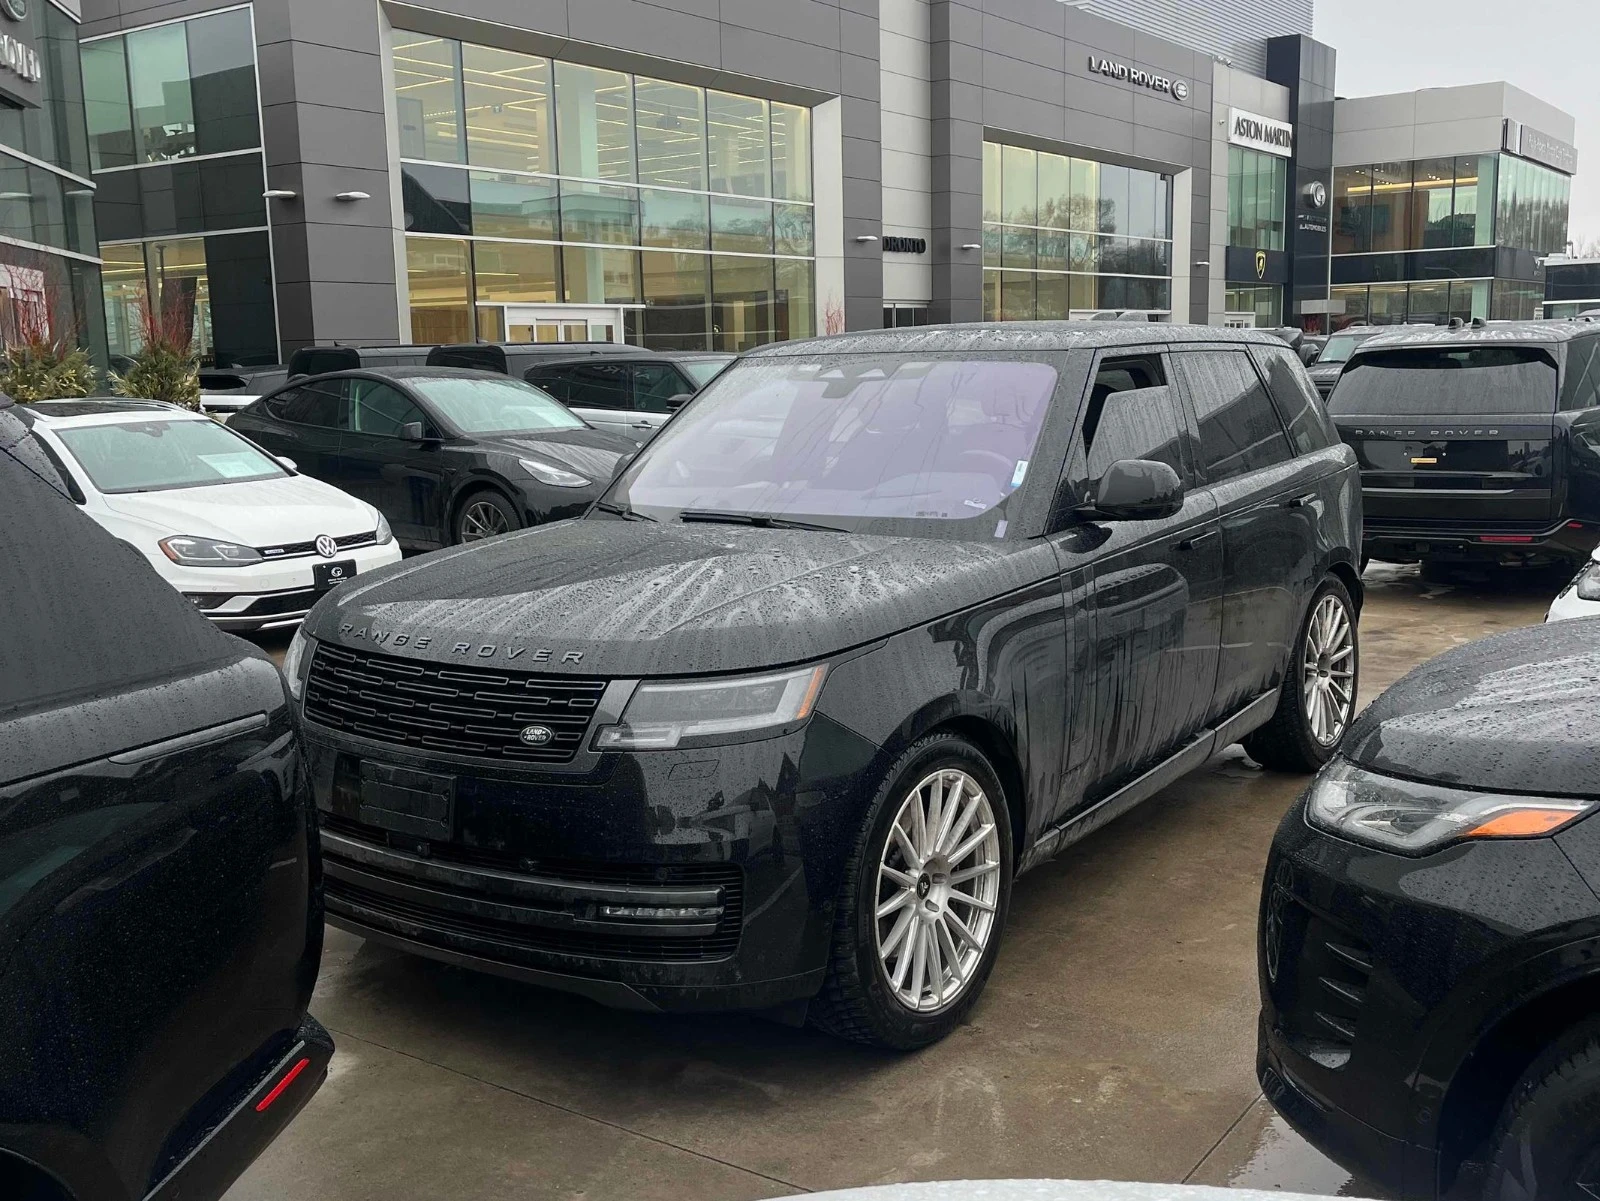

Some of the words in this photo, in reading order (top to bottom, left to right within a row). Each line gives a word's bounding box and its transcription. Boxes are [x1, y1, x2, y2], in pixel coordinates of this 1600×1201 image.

[1089, 56, 1128, 78] LAND
[1129, 68, 1171, 92] ROVER
[1234, 116, 1263, 141] ASTON
[1264, 124, 1291, 148] MARTIN
[883, 236, 926, 253] ORONTO
[338, 622, 432, 650] RANGE
[452, 641, 584, 664] ROVER
